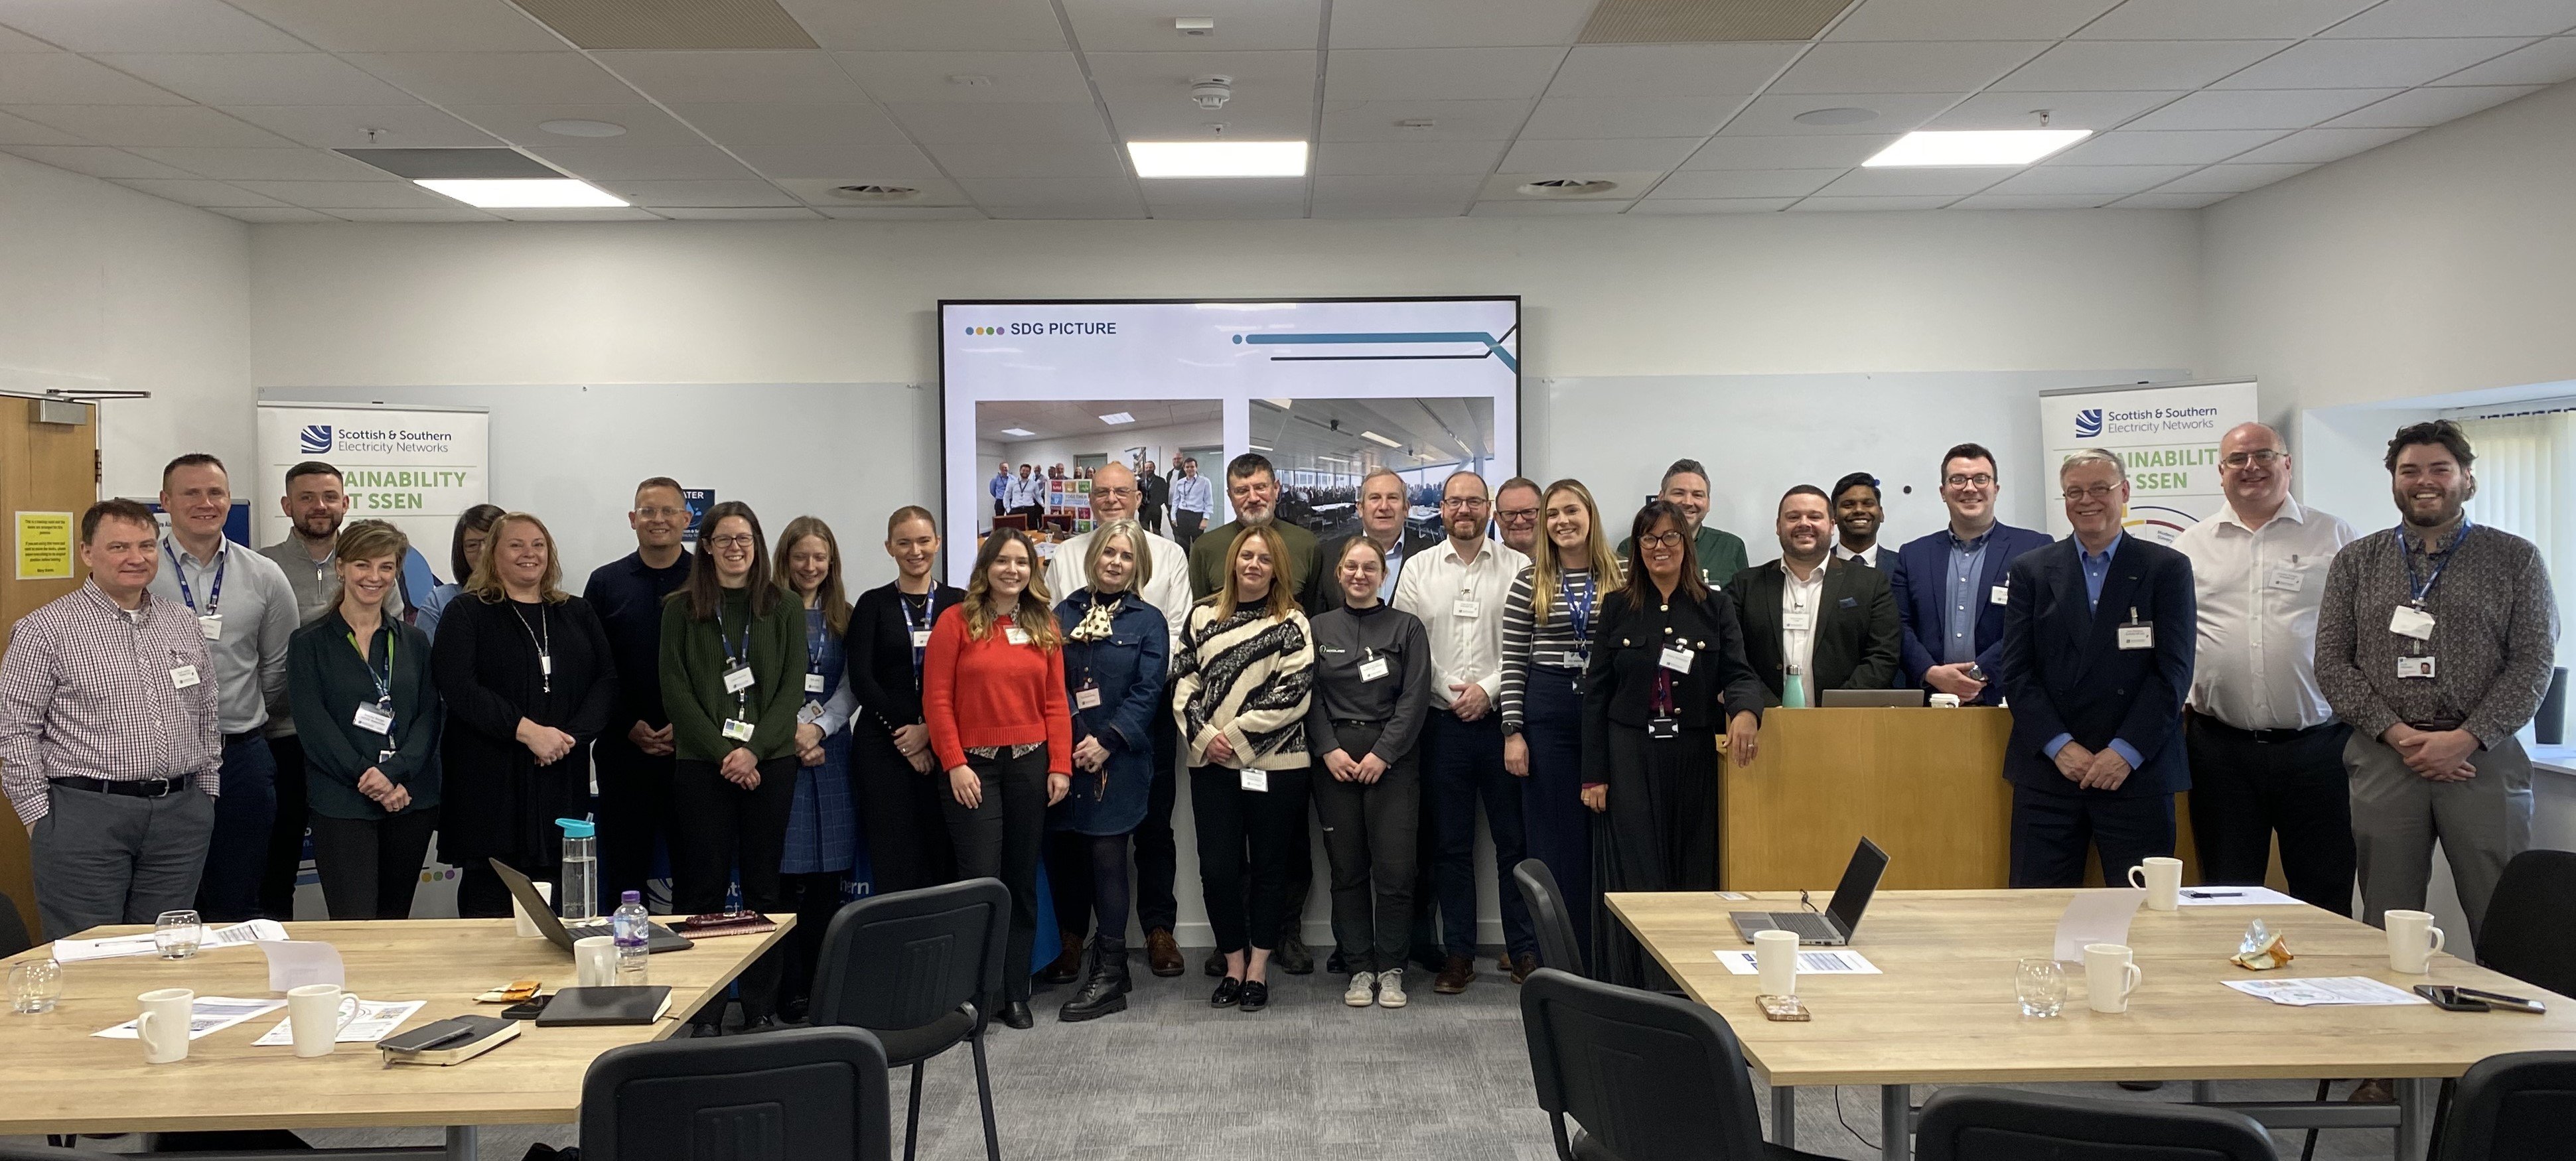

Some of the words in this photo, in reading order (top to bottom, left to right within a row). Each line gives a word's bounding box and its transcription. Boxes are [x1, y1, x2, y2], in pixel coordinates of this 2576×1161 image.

[1011, 322, 1044, 335] SDG
[1049, 322, 1116, 335] PICTURE
[2108, 409, 2153, 421] Scottish
[2155, 409, 2163, 419] &
[2166, 407, 2218, 418] Southern
[2108, 422, 2160, 434] Electricity
[2163, 419, 2214, 431] Networks
[338, 429, 386, 440] Scottish
[388, 429, 397, 440] &
[399, 430, 451, 441] Southern
[338, 441, 393, 454] Electricity
[396, 443, 449, 452] Networks
[2119, 448, 2218, 468] INABILIT
[341, 471, 466, 487] AINABILITY
[2135, 472, 2187, 490] SSEN
[348, 493, 362, 509] T
[368, 493, 422, 509] SSEN
[683, 491, 704, 500] TER
